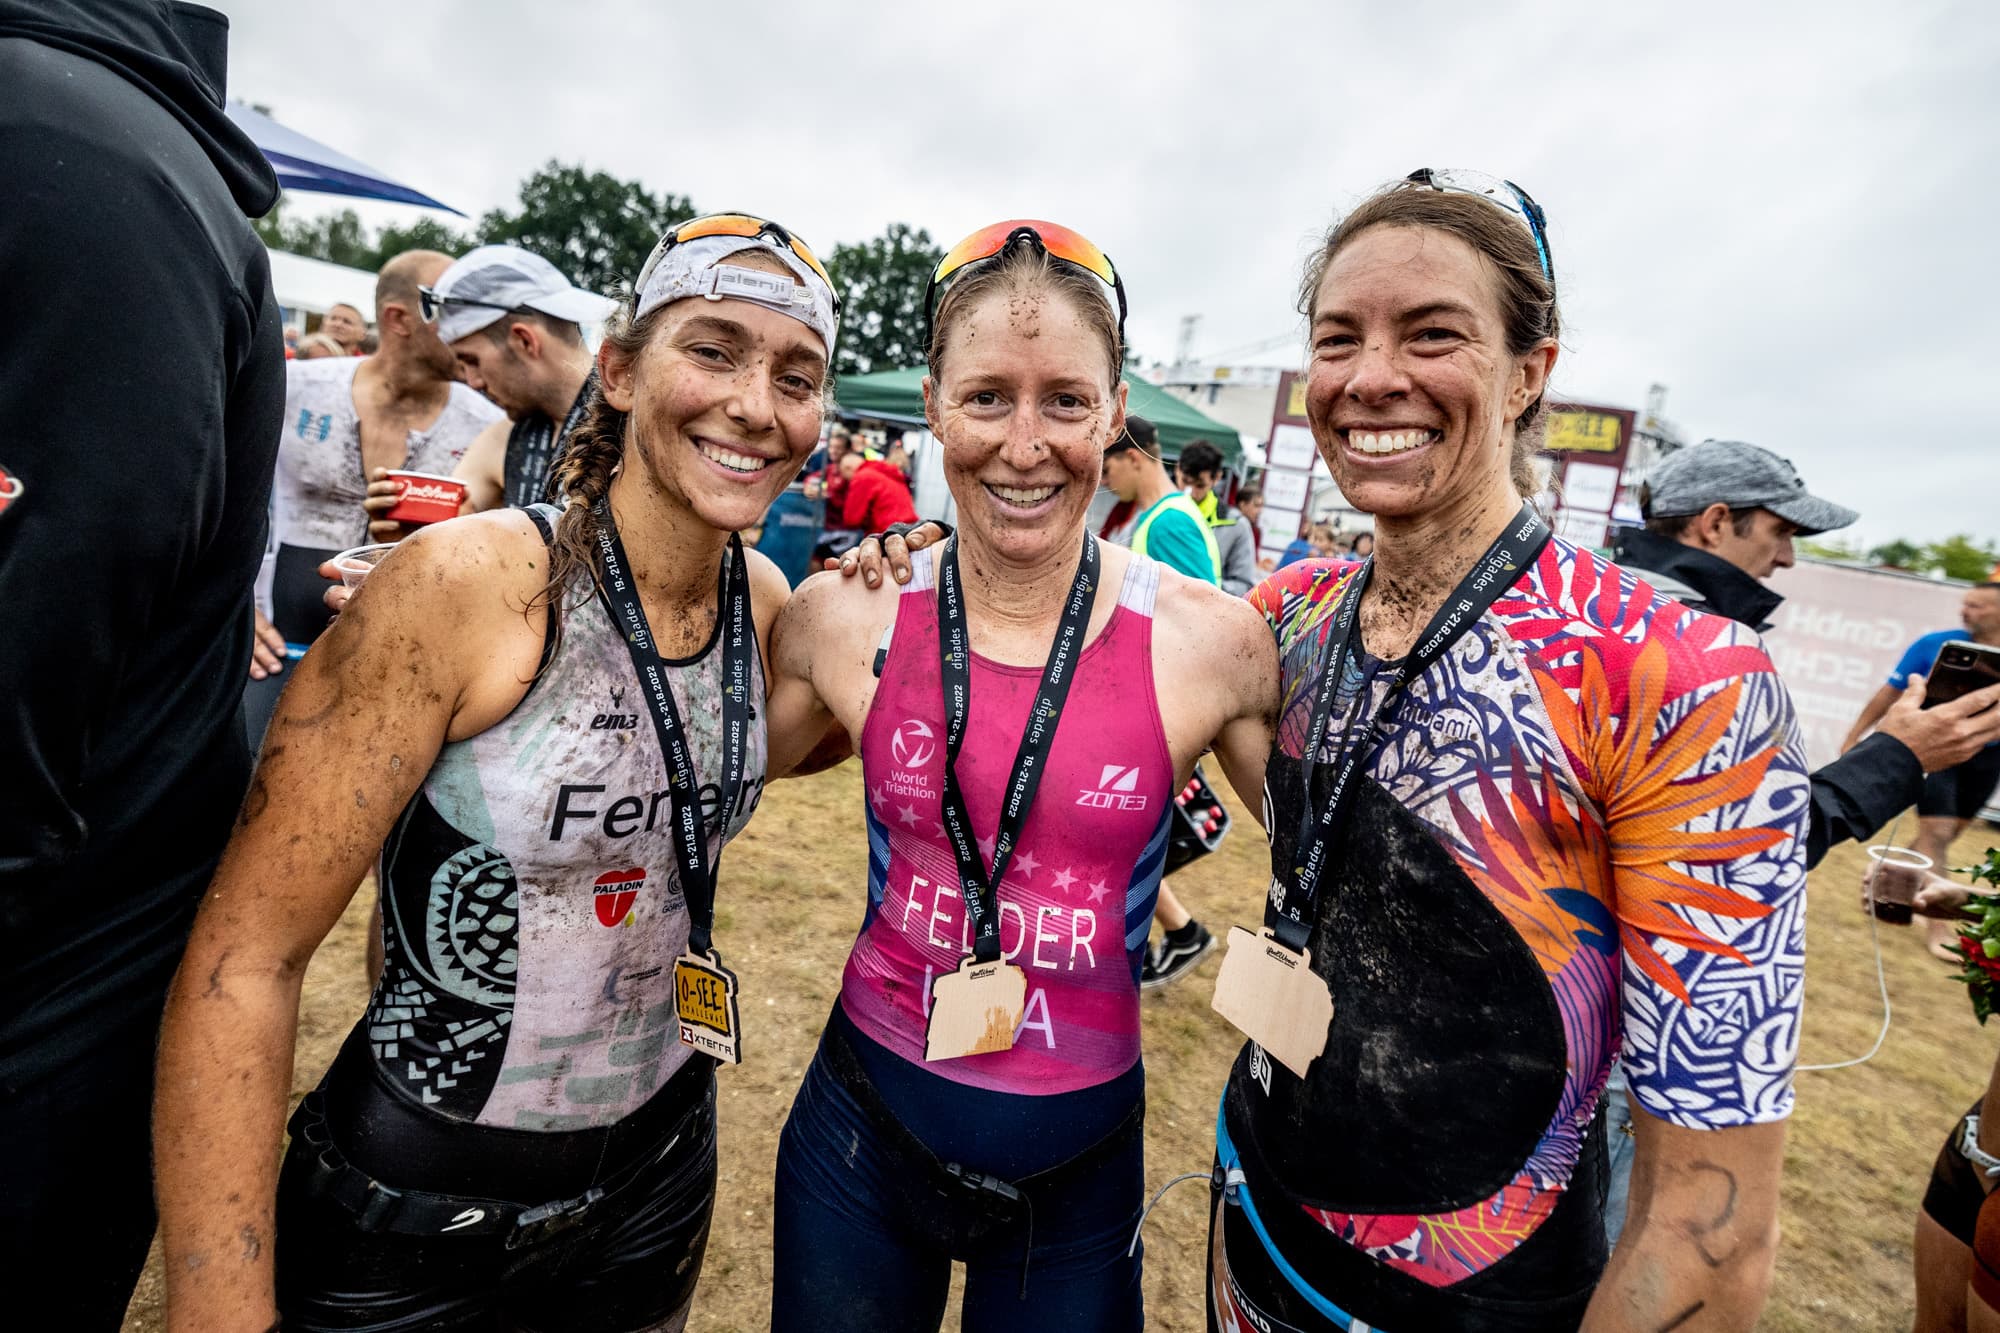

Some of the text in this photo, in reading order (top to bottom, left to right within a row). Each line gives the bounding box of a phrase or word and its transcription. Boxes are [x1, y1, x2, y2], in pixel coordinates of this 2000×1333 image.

[721, 273, 785, 294] alenji
[946, 564, 958, 619] 19.-21.8.2022
[1069, 574, 1090, 617] digades
[1472, 550, 1512, 592] digades
[624, 601, 649, 650] digades
[732, 594, 743, 647] 19.-21.8.2022
[1340, 586, 1359, 628] digades
[1417, 599, 1474, 658] 19.-21.8.2022
[949, 627, 963, 670] digades
[1049, 625, 1076, 685] 19.-21.8.2022
[646, 664, 674, 730] 19.-21.8.2022
[731, 659, 744, 703] digades
[1321, 643, 1341, 704] 19.-21.8.2022
[947, 684, 964, 745] 19.-21.8.2022
[1029, 697, 1052, 745] digades
[1305, 712, 1324, 760] digades
[1398, 698, 1473, 741] kiwami
[671, 740, 689, 790] digades
[730, 720, 741, 781] 19.-21.8.2022
[884, 779, 936, 800] Triathlon
[891, 769, 928, 786] World
[1007, 754, 1035, 819] 19.-21.8.2022
[1322, 758, 1355, 825] 19.-21.8.2022
[681, 804, 700, 870] 19.-21.8.2022
[946, 804, 972, 863] 19.-21.8.2022
[593, 880, 644, 895] PALADIN
[1299, 839, 1325, 891] digades
[966, 879, 986, 922] digad
[681, 974, 723, 1013] O-SEE
